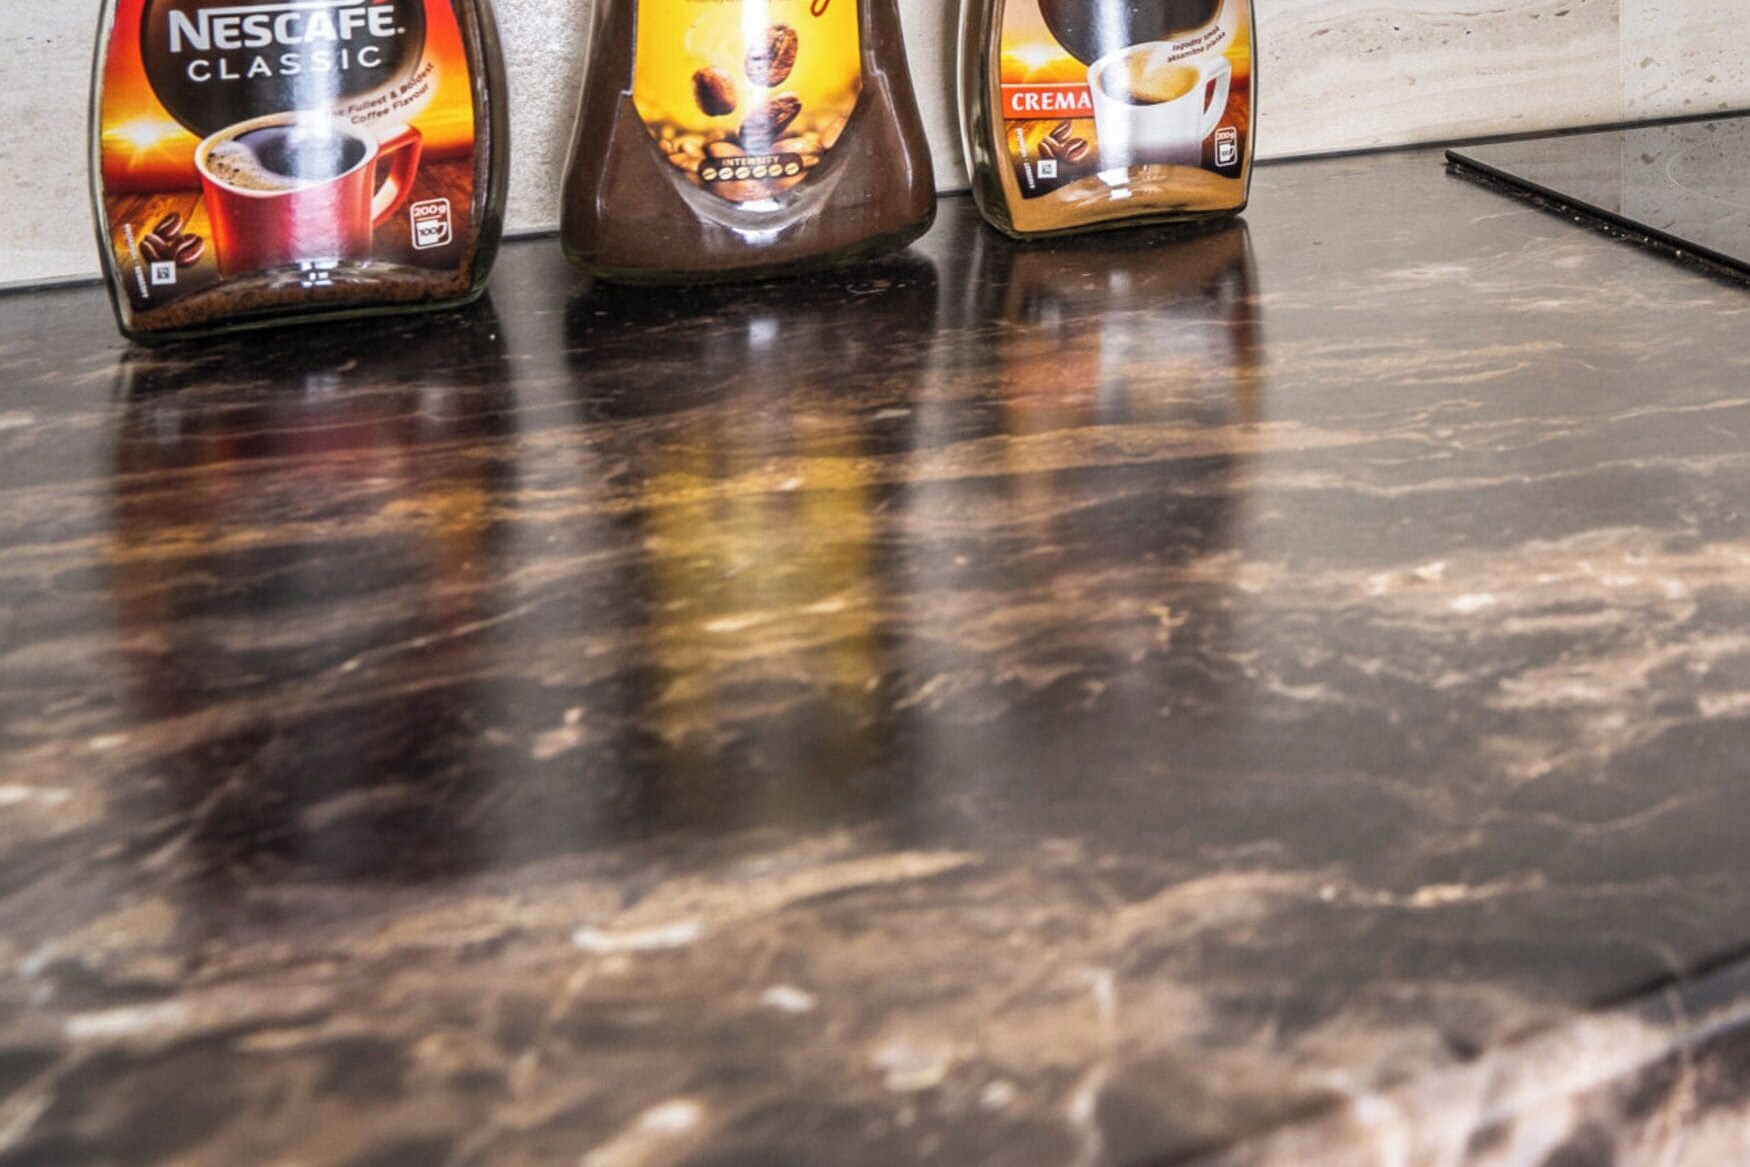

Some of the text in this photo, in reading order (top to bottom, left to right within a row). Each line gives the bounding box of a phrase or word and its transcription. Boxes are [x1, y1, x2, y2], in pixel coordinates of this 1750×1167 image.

[187, 46, 383, 82] CLASSIC
[1011, 91, 1094, 111] CREMA
[351, 108, 390, 125] Coffee
[722, 155, 780, 167] INTENSITY
